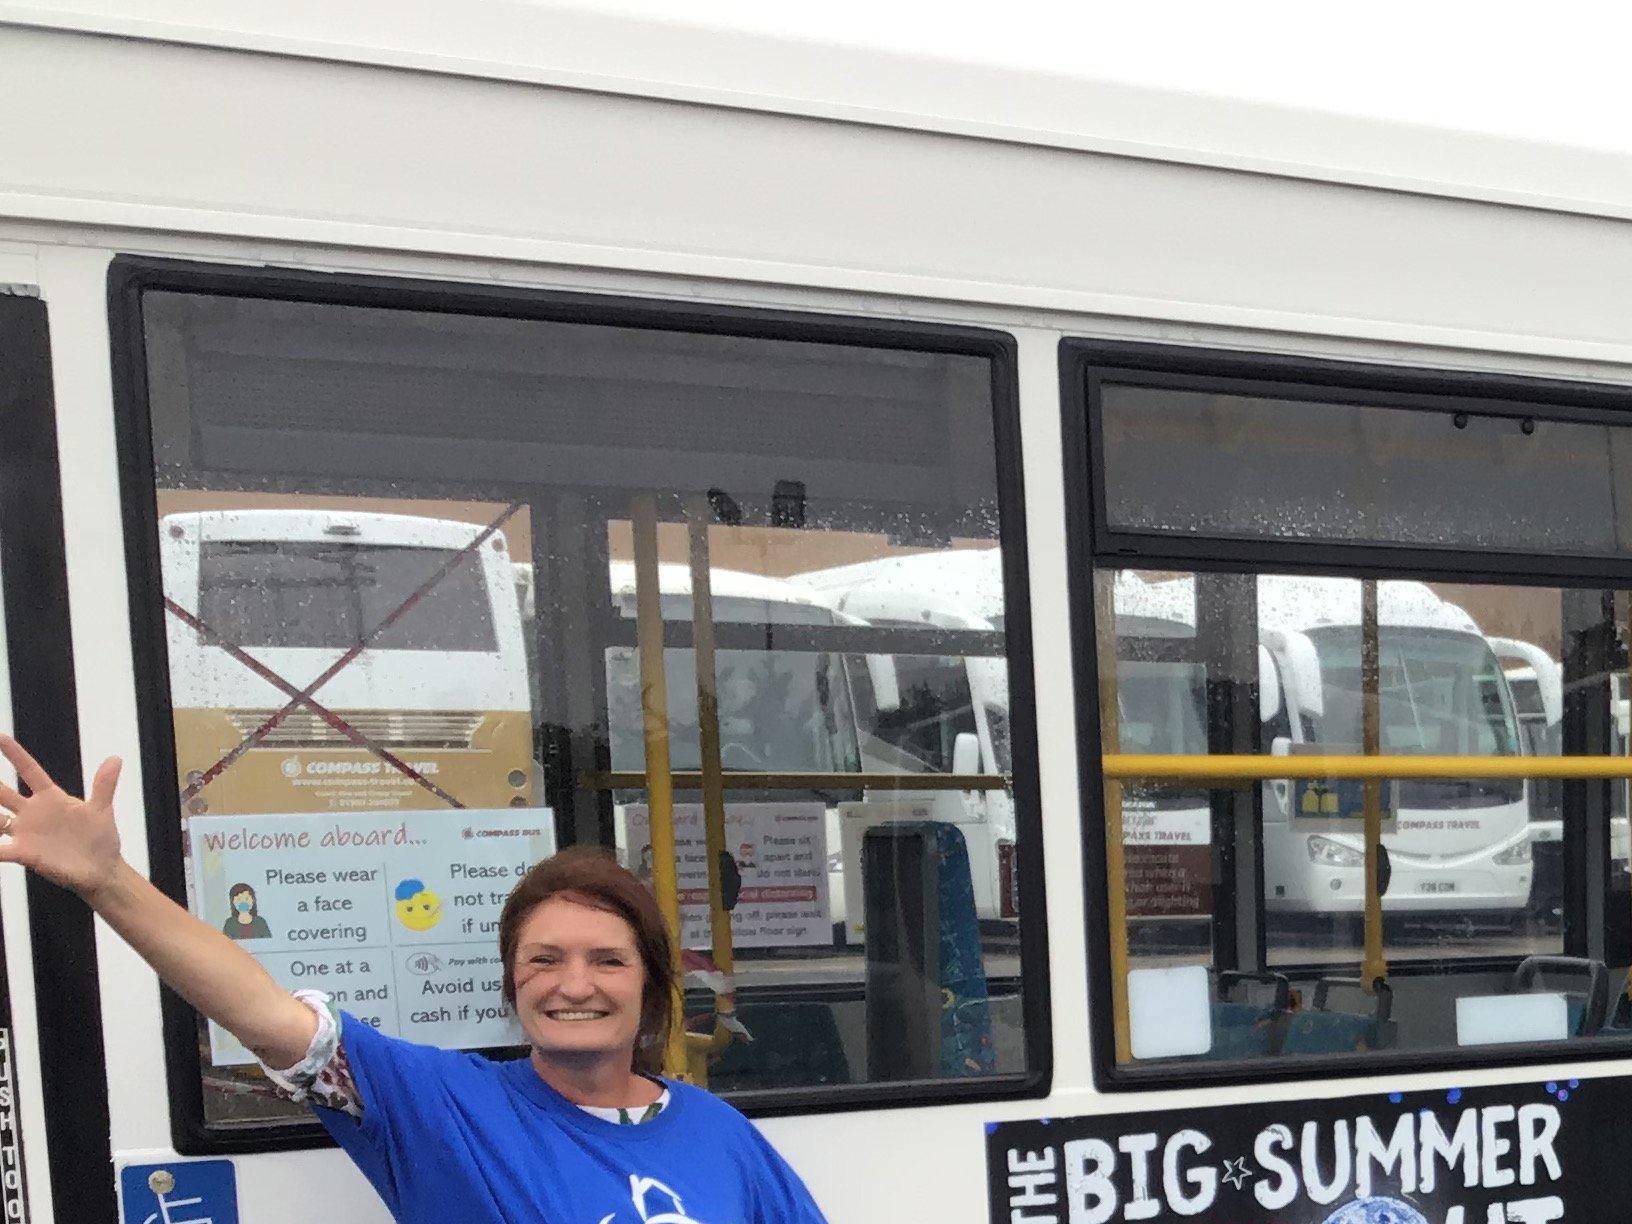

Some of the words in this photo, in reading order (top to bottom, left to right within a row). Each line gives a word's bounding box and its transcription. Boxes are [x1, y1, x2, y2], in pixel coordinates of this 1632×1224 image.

[306, 762, 381, 775] COMPASS
[204, 827, 311, 852] Welcome
[476, 829, 520, 838] COMPASS
[265, 869, 327, 885] Please
[332, 868, 378, 883] wear
[450, 863, 508, 879] Please
[297, 900, 309, 912] a
[314, 896, 353, 911] face
[454, 892, 484, 906] not
[287, 923, 367, 943] covering
[462, 918, 473, 933] if
[290, 960, 329, 976] One
[335, 960, 353, 974] at
[359, 961, 371, 973] a
[355, 984, 388, 1001] and
[421, 978, 474, 995] Avoid
[410, 1007, 451, 1023] cash
[458, 1005, 469, 1020] if
[1254, 1102, 1562, 1211] SUMMER
